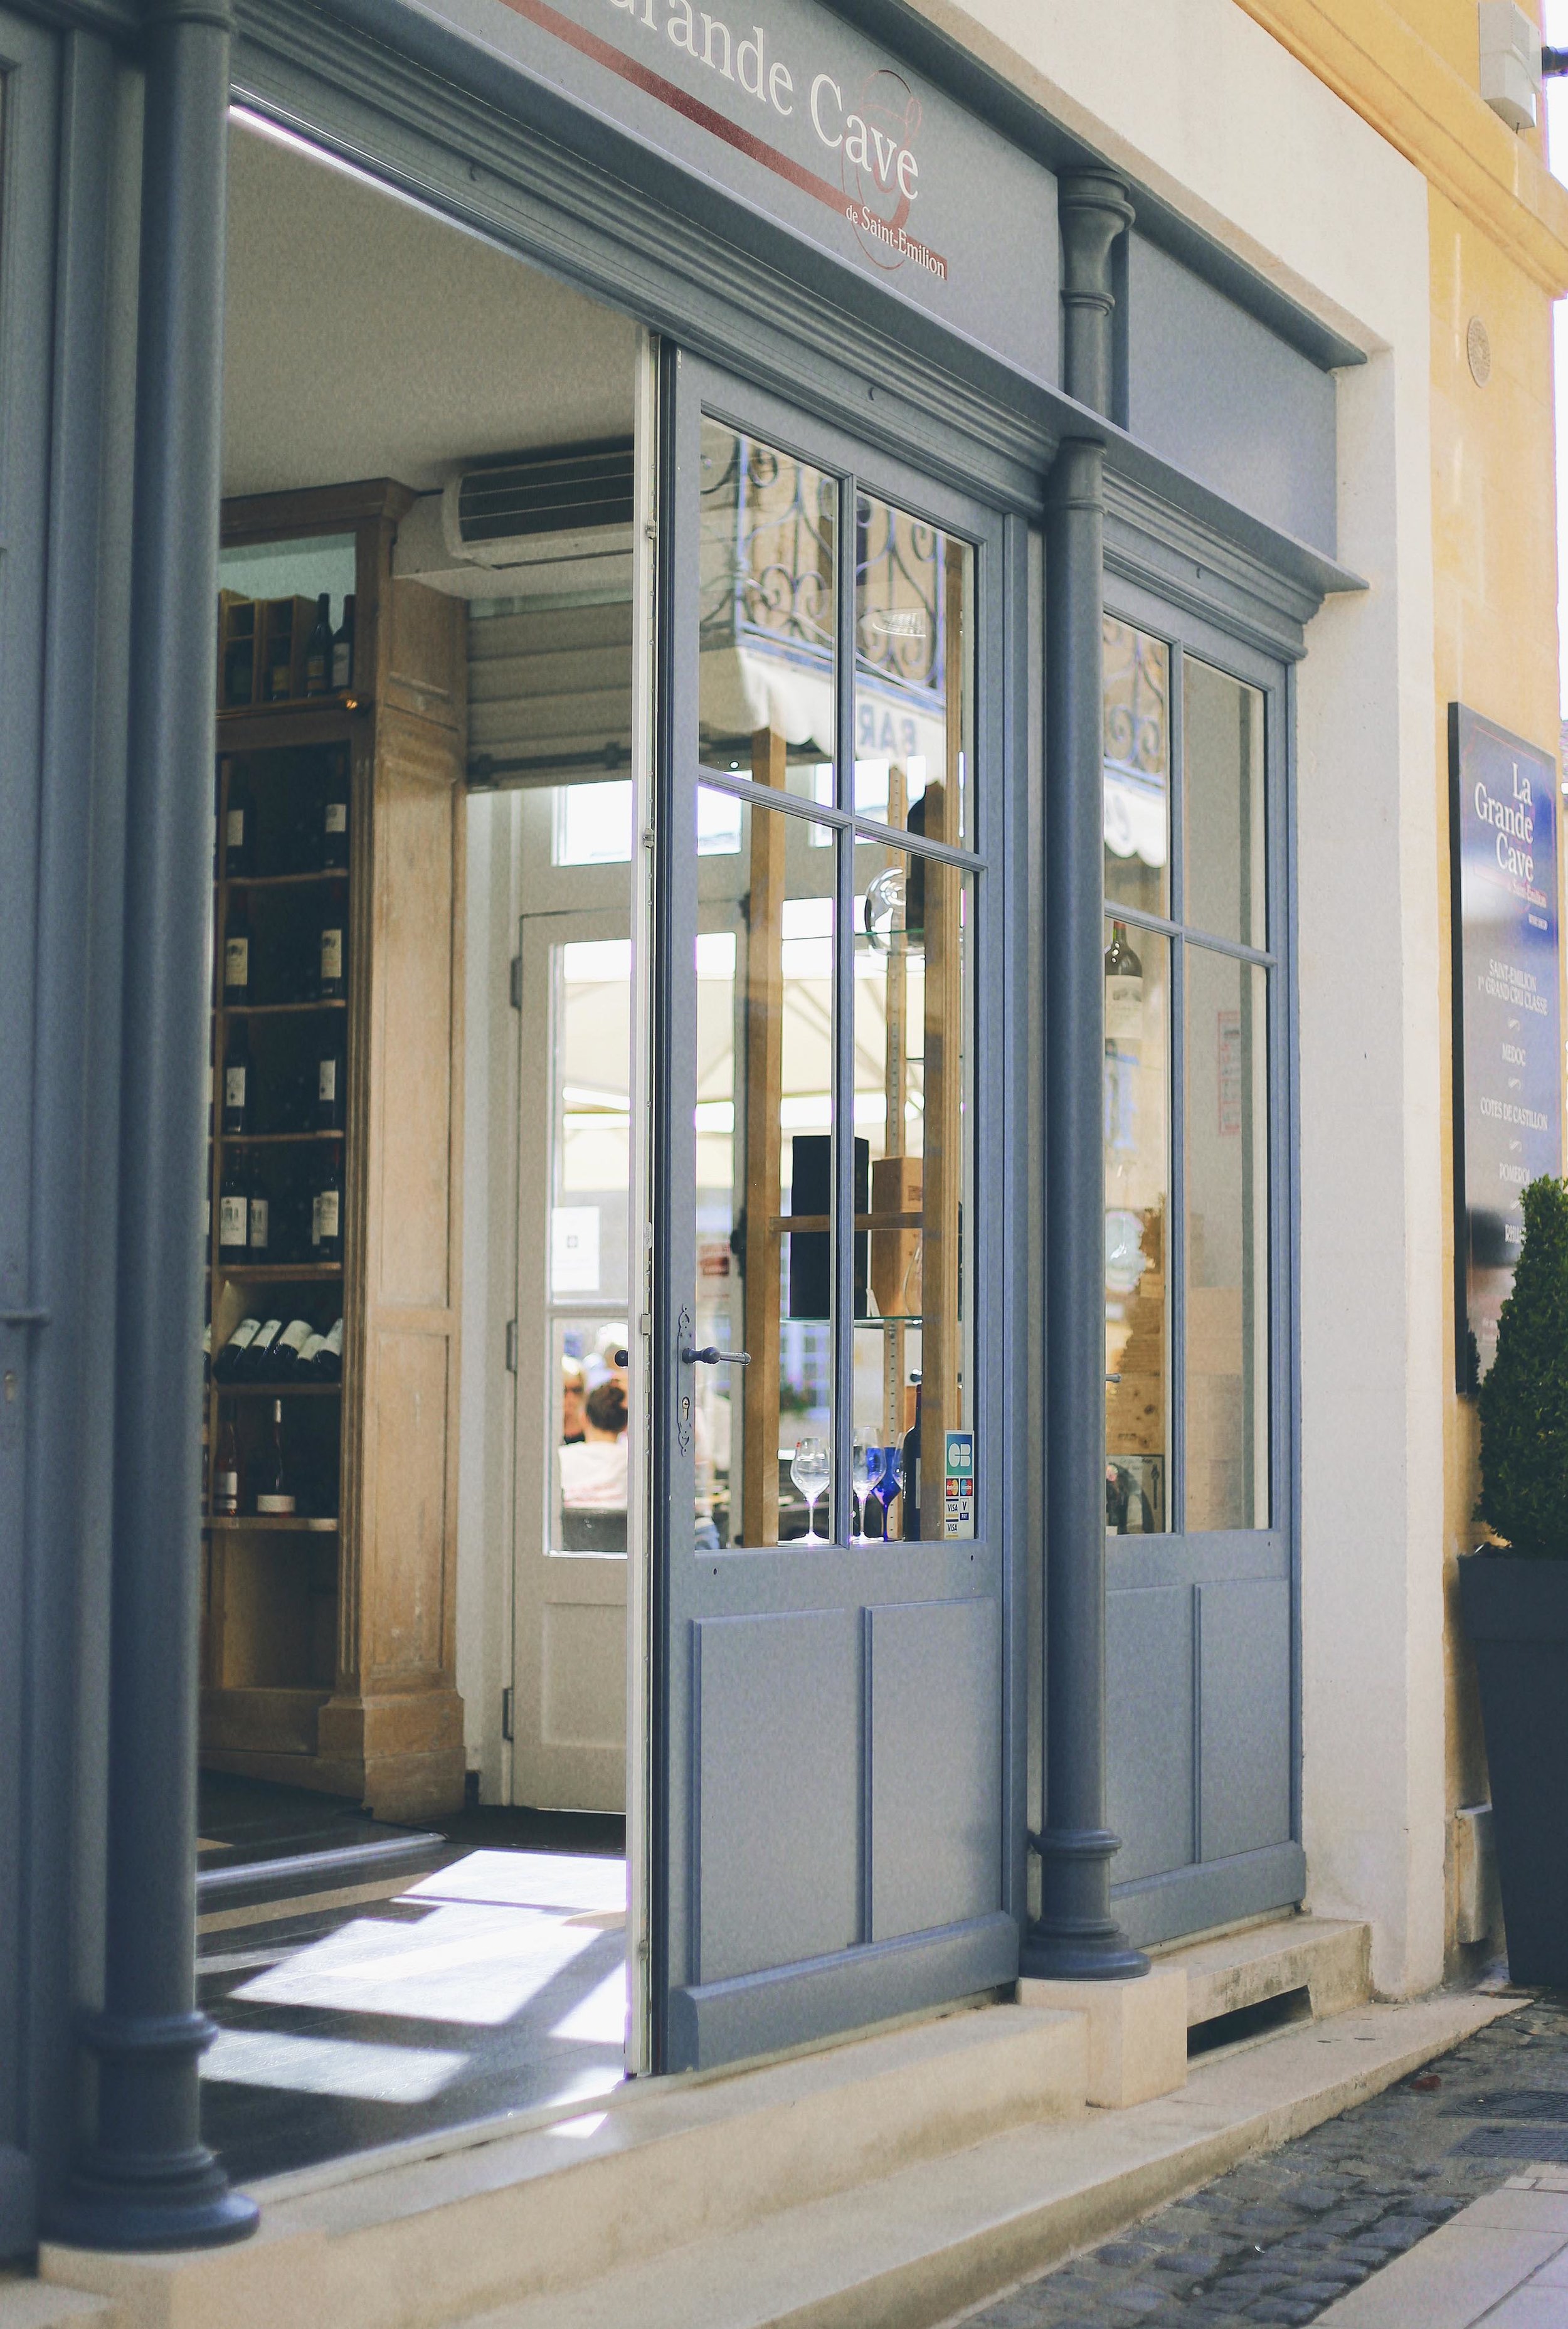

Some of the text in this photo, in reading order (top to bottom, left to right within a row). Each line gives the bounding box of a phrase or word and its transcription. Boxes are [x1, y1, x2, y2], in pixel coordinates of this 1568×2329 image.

[810, 73, 918, 199] Cave
[846, 205, 945, 279] de Saint-Emilion
[1512, 761, 1532, 806] La
[1475, 782, 1534, 844] Grande
[1496, 832, 1534, 883] Cave
[948, 1443, 971, 1467] CB
[947, 1504, 958, 1512] VISA
[947, 1524, 958, 1532] VISA
[961, 1501, 967, 1511] V
